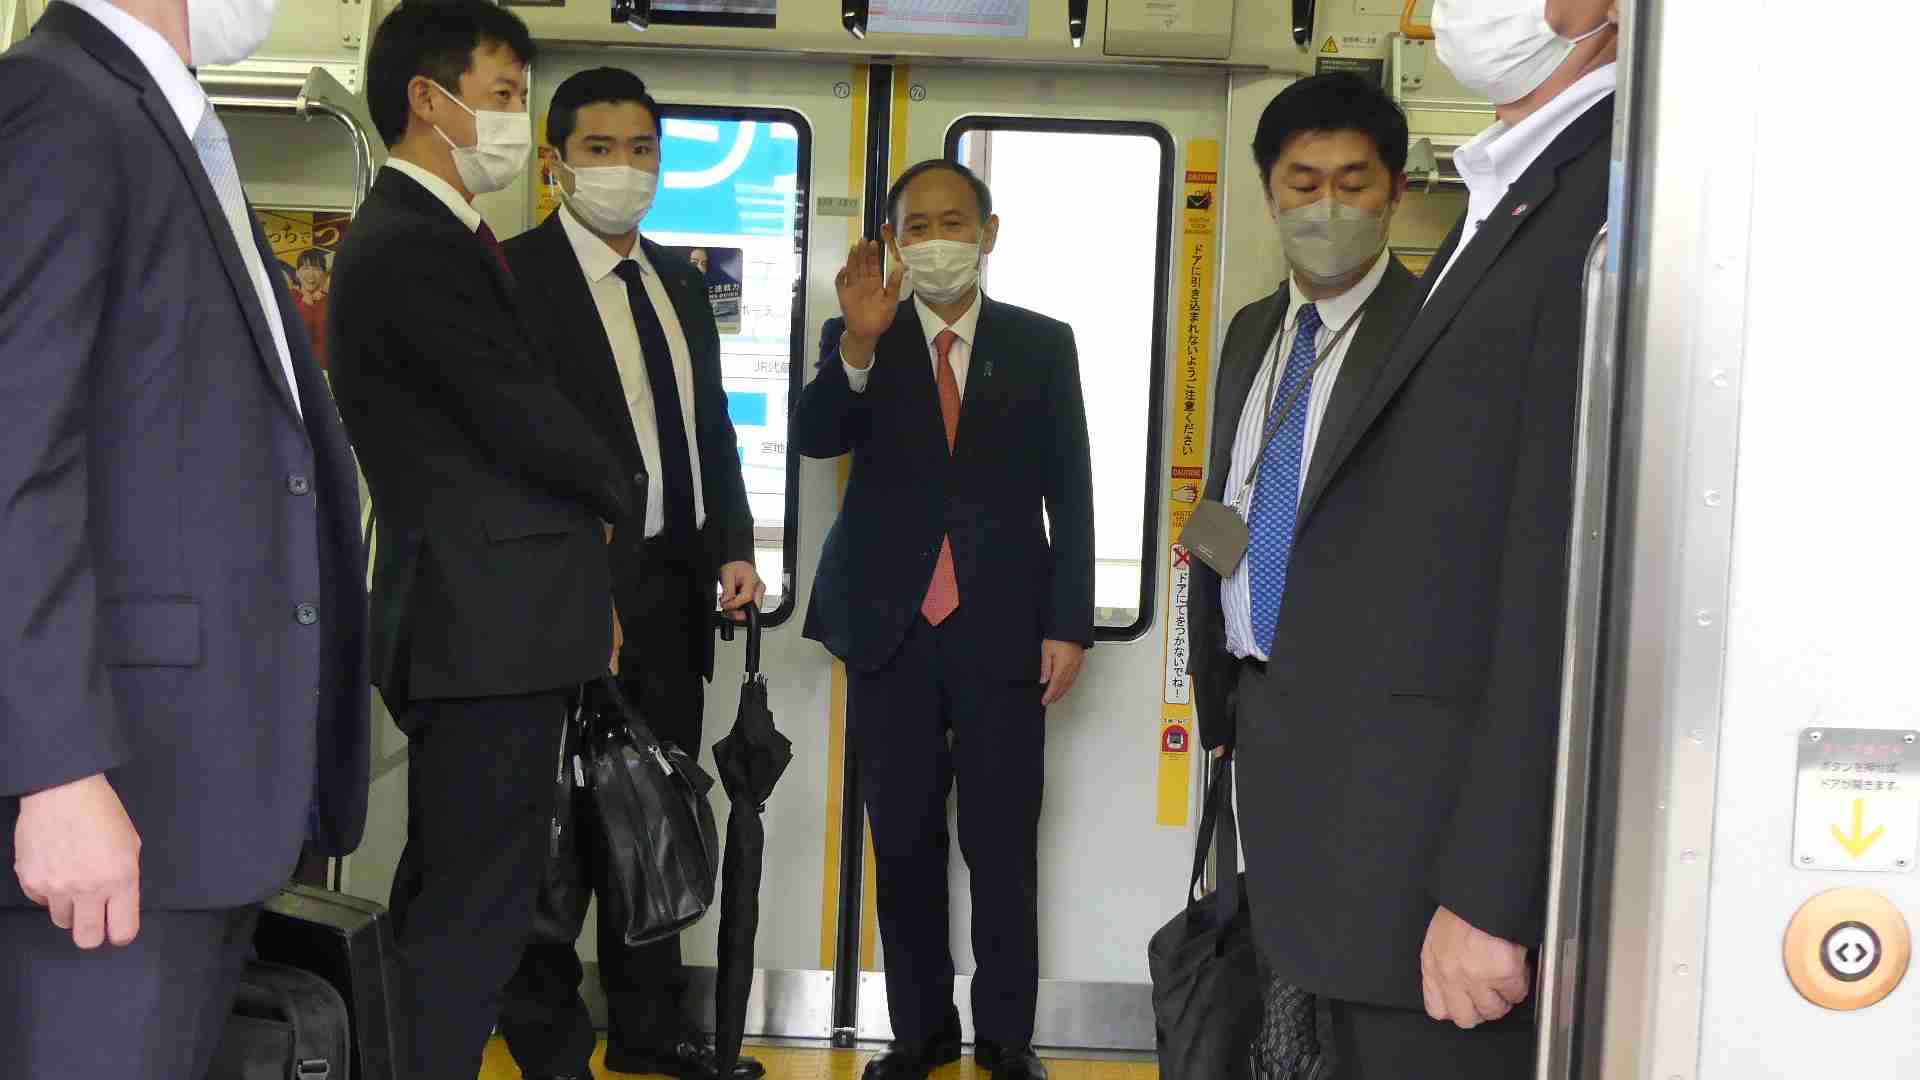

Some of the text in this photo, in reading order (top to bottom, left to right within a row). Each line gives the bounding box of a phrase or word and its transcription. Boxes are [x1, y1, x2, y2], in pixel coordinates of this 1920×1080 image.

[1182, 243, 1204, 456] ドアに引き込まれないようご注意ください
